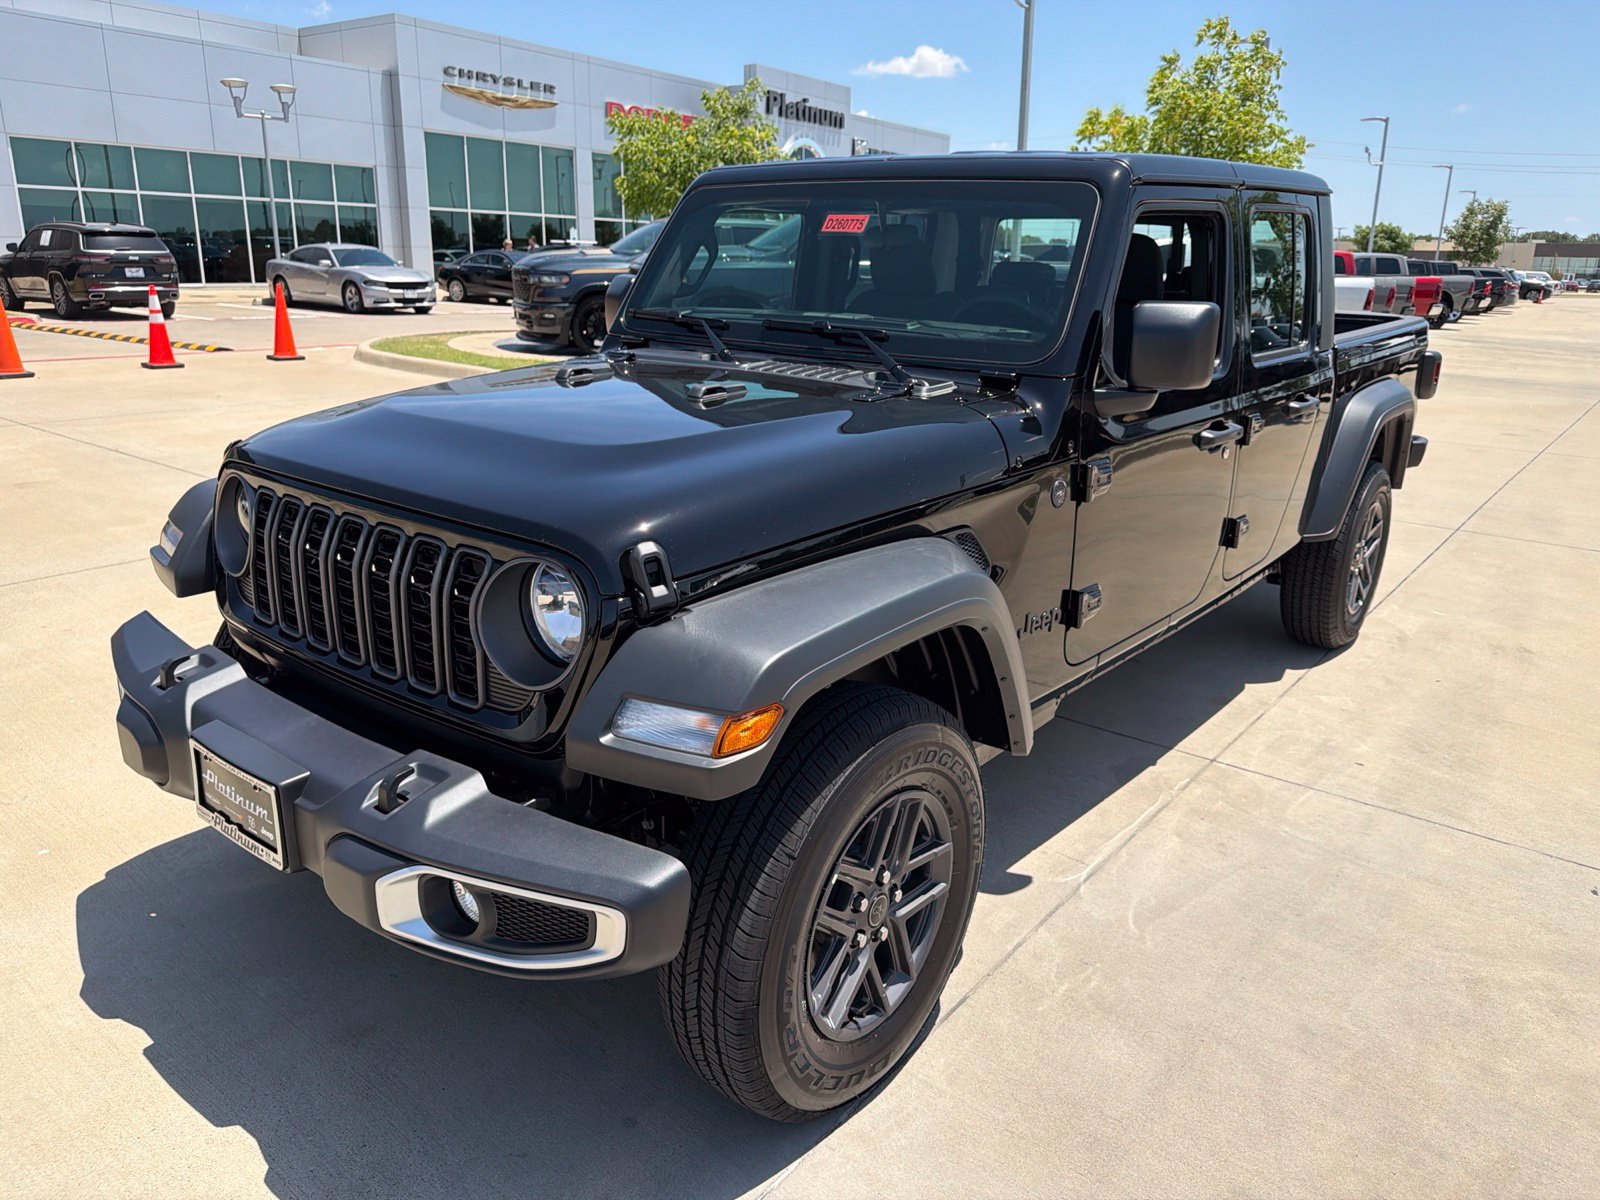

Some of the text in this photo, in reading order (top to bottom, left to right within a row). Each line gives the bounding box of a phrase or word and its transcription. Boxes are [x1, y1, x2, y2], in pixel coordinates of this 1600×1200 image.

[443, 66, 556, 95] CHRYSLER
[766, 90, 845, 129] Platinum
[825, 218, 866, 230] D260775
[1016, 606, 1063, 640] Jeep
[202, 769, 273, 824] Platinum
[214, 815, 264, 857] Platinum
